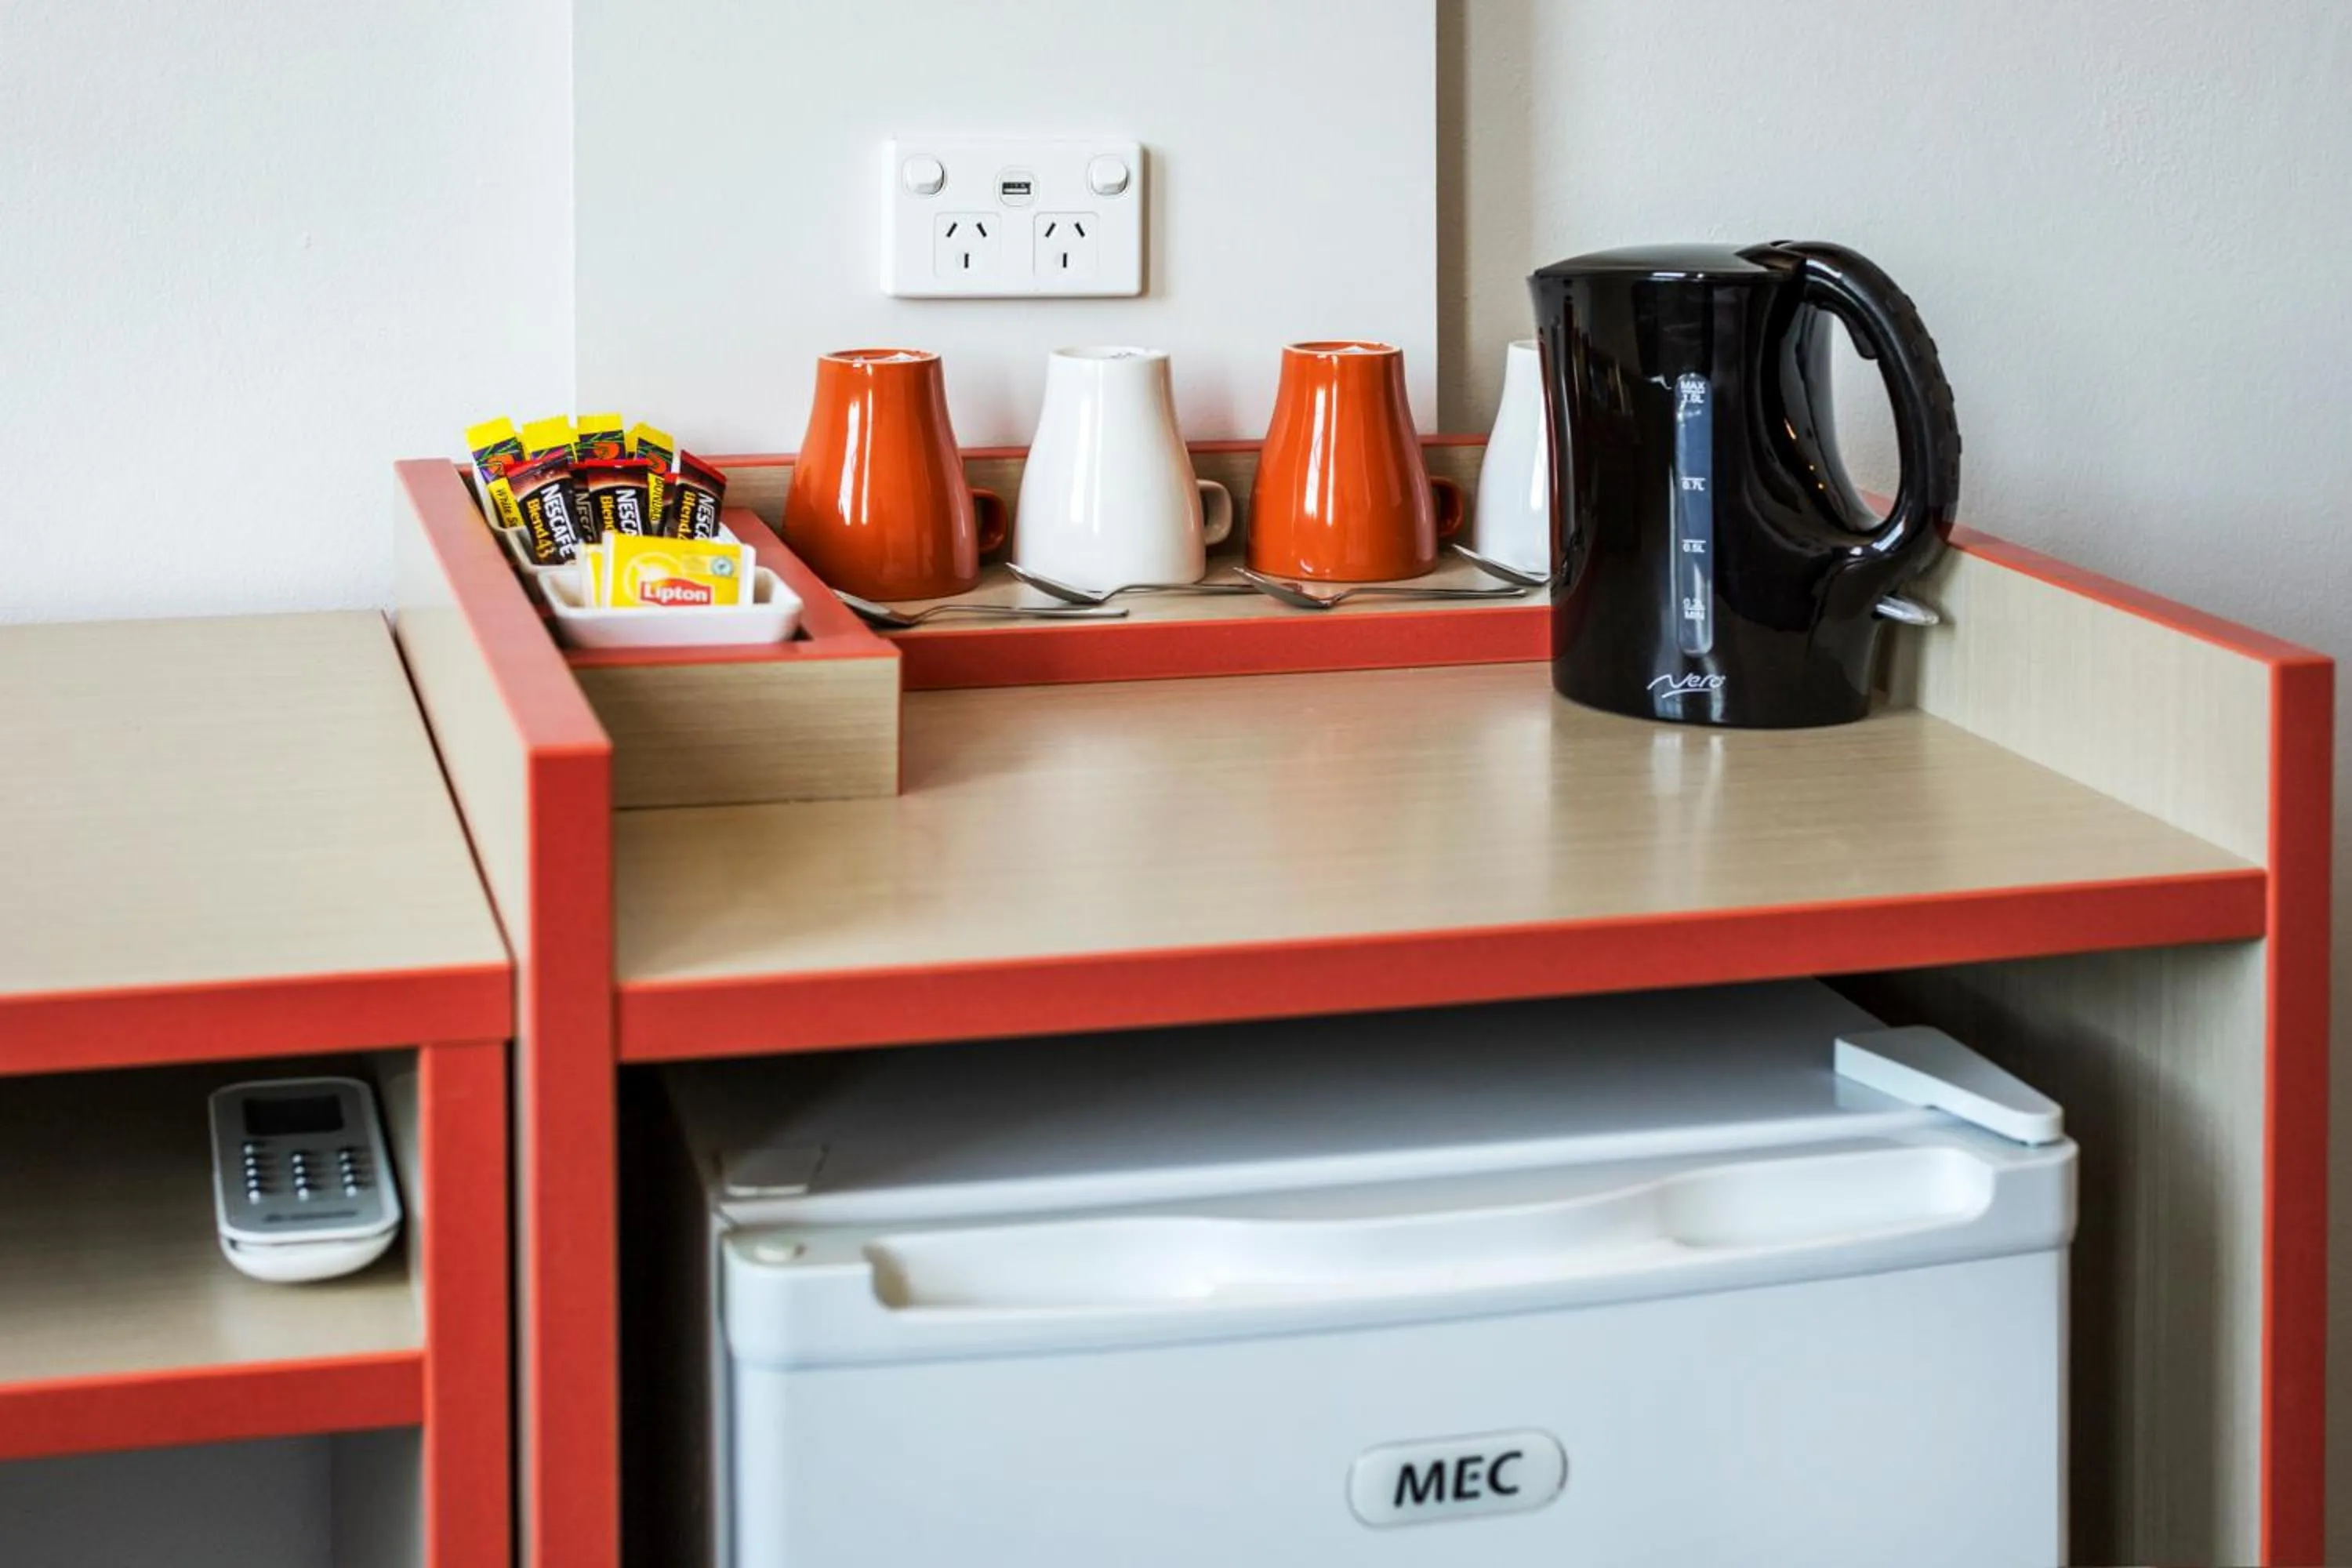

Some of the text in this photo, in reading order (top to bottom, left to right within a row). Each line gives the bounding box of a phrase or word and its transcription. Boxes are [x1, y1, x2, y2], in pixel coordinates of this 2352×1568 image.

[1680, 380, 1706, 391] MAX
[677, 490, 696, 533] Blend
[526, 498, 557, 559] Blend 43
[643, 582, 708, 602] Lipton
[1646, 673, 1725, 695] Nero
[1393, 1450, 1523, 1508] MEC
